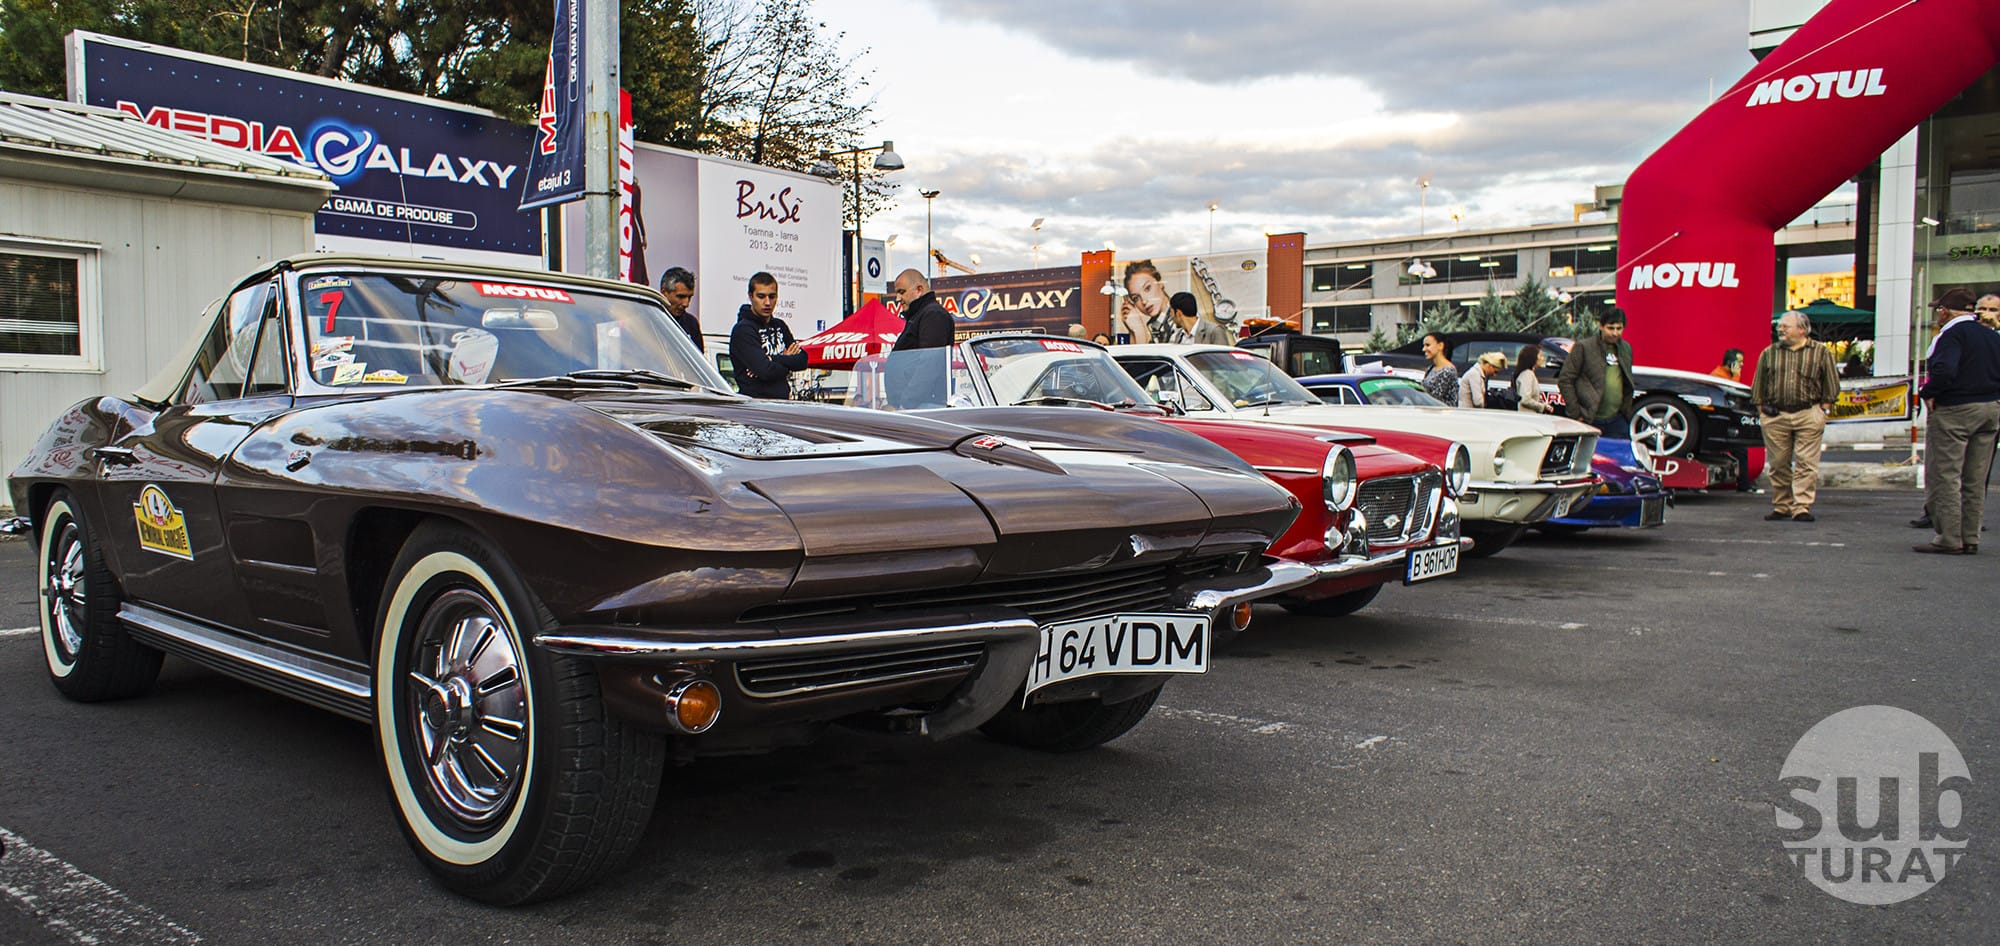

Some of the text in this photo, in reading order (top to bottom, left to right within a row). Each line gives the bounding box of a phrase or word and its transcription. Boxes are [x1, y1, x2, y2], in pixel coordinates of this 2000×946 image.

[1746, 67, 1888, 107] MOTUL
[313, 129, 518, 189] GALAXY
[538, 169, 571, 191] etajul 3
[377, 203, 394, 217] DE
[396, 207, 454, 225] PRODUSE
[744, 225, 775, 238] Toamna
[749, 239, 769, 250] 2013
[775, 242, 793, 253] 2014
[1950, 244, 2000, 259] STA
[1628, 261, 1740, 290] MOTUL
[481, 284, 570, 301] MOTUL
[320, 291, 344, 332] 7
[822, 343, 868, 360] MOTUL
[1413, 553, 1421, 577] B
[1059, 625, 1096, 674] 64
[1104, 622, 1205, 667] VDM
